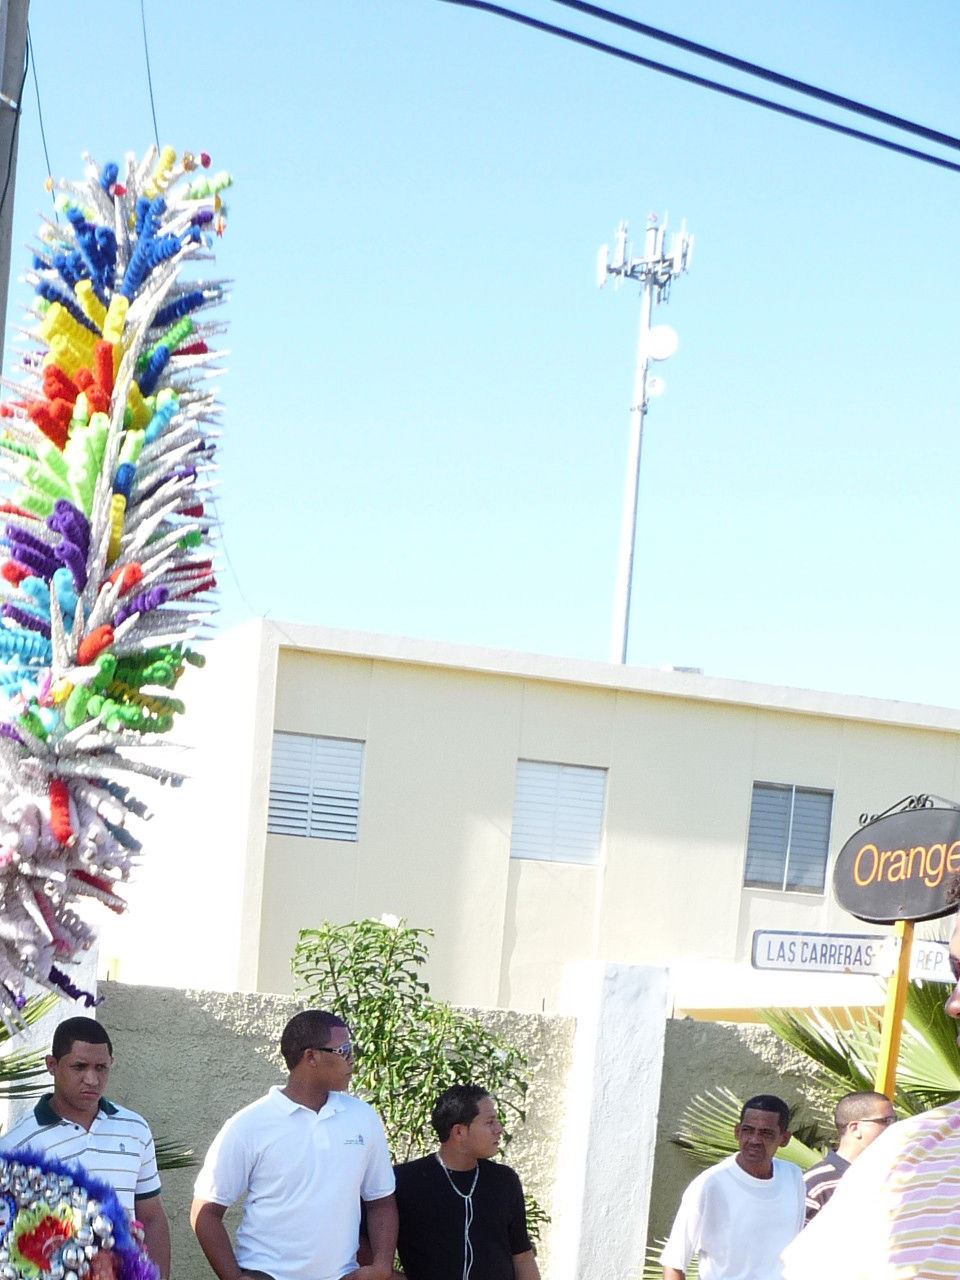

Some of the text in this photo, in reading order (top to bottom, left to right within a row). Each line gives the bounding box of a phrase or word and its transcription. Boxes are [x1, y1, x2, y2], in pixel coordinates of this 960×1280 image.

[853, 840, 960, 888] Orange
[766, 940, 797, 963] LAS
[800, 941, 874, 967] CARRERAS
